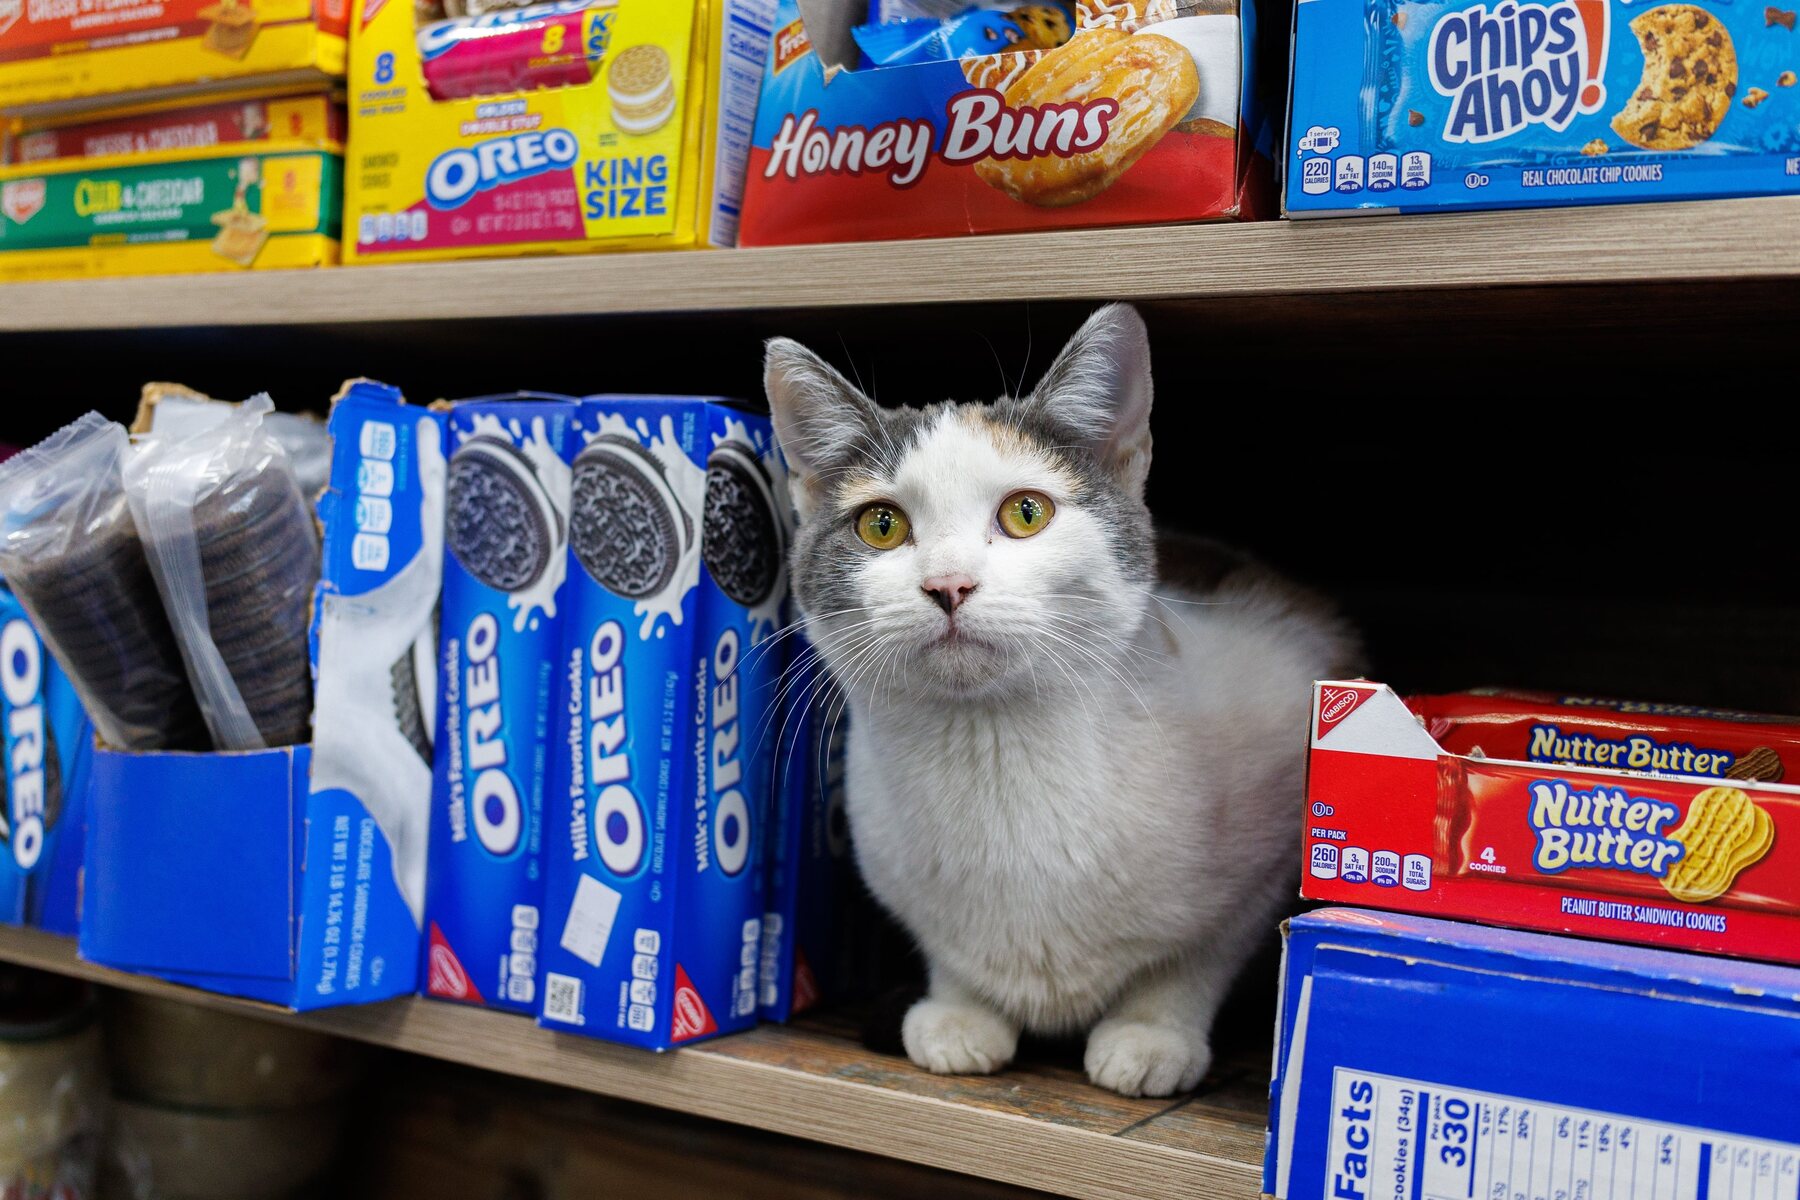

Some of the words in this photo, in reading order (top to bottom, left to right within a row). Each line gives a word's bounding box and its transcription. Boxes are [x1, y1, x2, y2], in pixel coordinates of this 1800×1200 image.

[542, 25, 566, 54] 8
[1434, 4, 1576, 89] Chips
[374, 52, 395, 84] 8
[765, 112, 930, 184] Honey
[944, 95, 1112, 160] Buns
[1313, 130, 1338, 138] serving
[429, 130, 575, 201] OREO
[585, 155, 668, 188] KING
[1306, 162, 1329, 176] 220
[1350, 172, 1360, 180] FAT
[1522, 170, 1545, 187] REAL
[1546, 167, 1598, 186] CHOCOLATE
[1600, 166, 1621, 184] CHIP
[1622, 164, 1663, 183] COOKIES
[586, 186, 667, 220] SIZE
[567, 648, 583, 713] Cookie
[695, 657, 708, 725] Cookie
[1324, 692, 1355, 720] NABISCO
[0, 617, 44, 869] OREO
[466, 613, 521, 854] OREO
[589, 619, 643, 873] OREO
[712, 629, 749, 874] OREO
[1532, 727, 1626, 765] Nutter
[1627, 738, 1728, 776] Butter
[567, 715, 585, 798] Favorite
[658, 758, 671, 790] COOKIES
[694, 727, 707, 809] Favorite
[656, 790, 668, 830] SANDWICH
[1532, 783, 1675, 835] Nutter
[570, 799, 588, 861] Milk's
[694, 810, 710, 872] Milk's
[1312, 828, 1326, 838] PER
[1327, 830, 1346, 840] PACK
[653, 832, 666, 874] CHOCOLATE
[1312, 862, 1336, 870] CALORIES
[1314, 846, 1336, 862] 260
[1344, 862, 1355, 870] SAT
[1356, 863, 1364, 871] FAT
[1469, 862, 1507, 874] COOKIES
[1480, 847, 1496, 864] 4
[1538, 828, 1680, 873] Butter
[1374, 866, 1396, 875] SODIUM
[1406, 878, 1427, 886] SUGARS
[1408, 870, 1424, 879] TOTAL
[1561, 896, 1597, 916] PEANUT
[1598, 901, 1632, 921] BUTTER
[1634, 906, 1684, 927] SANDWICH
[1686, 912, 1726, 933] COOKIES
[1397, 1089, 1415, 1132] (34g)
[1498, 1106, 1511, 1134] 17%
[1558, 1116, 1570, 1138] 0%
[1334, 1080, 1373, 1200] Facts
[1440, 1098, 1470, 1168] 330
[1578, 1120, 1590, 1148] 11%
[1393, 1139, 1408, 1200] cookies
